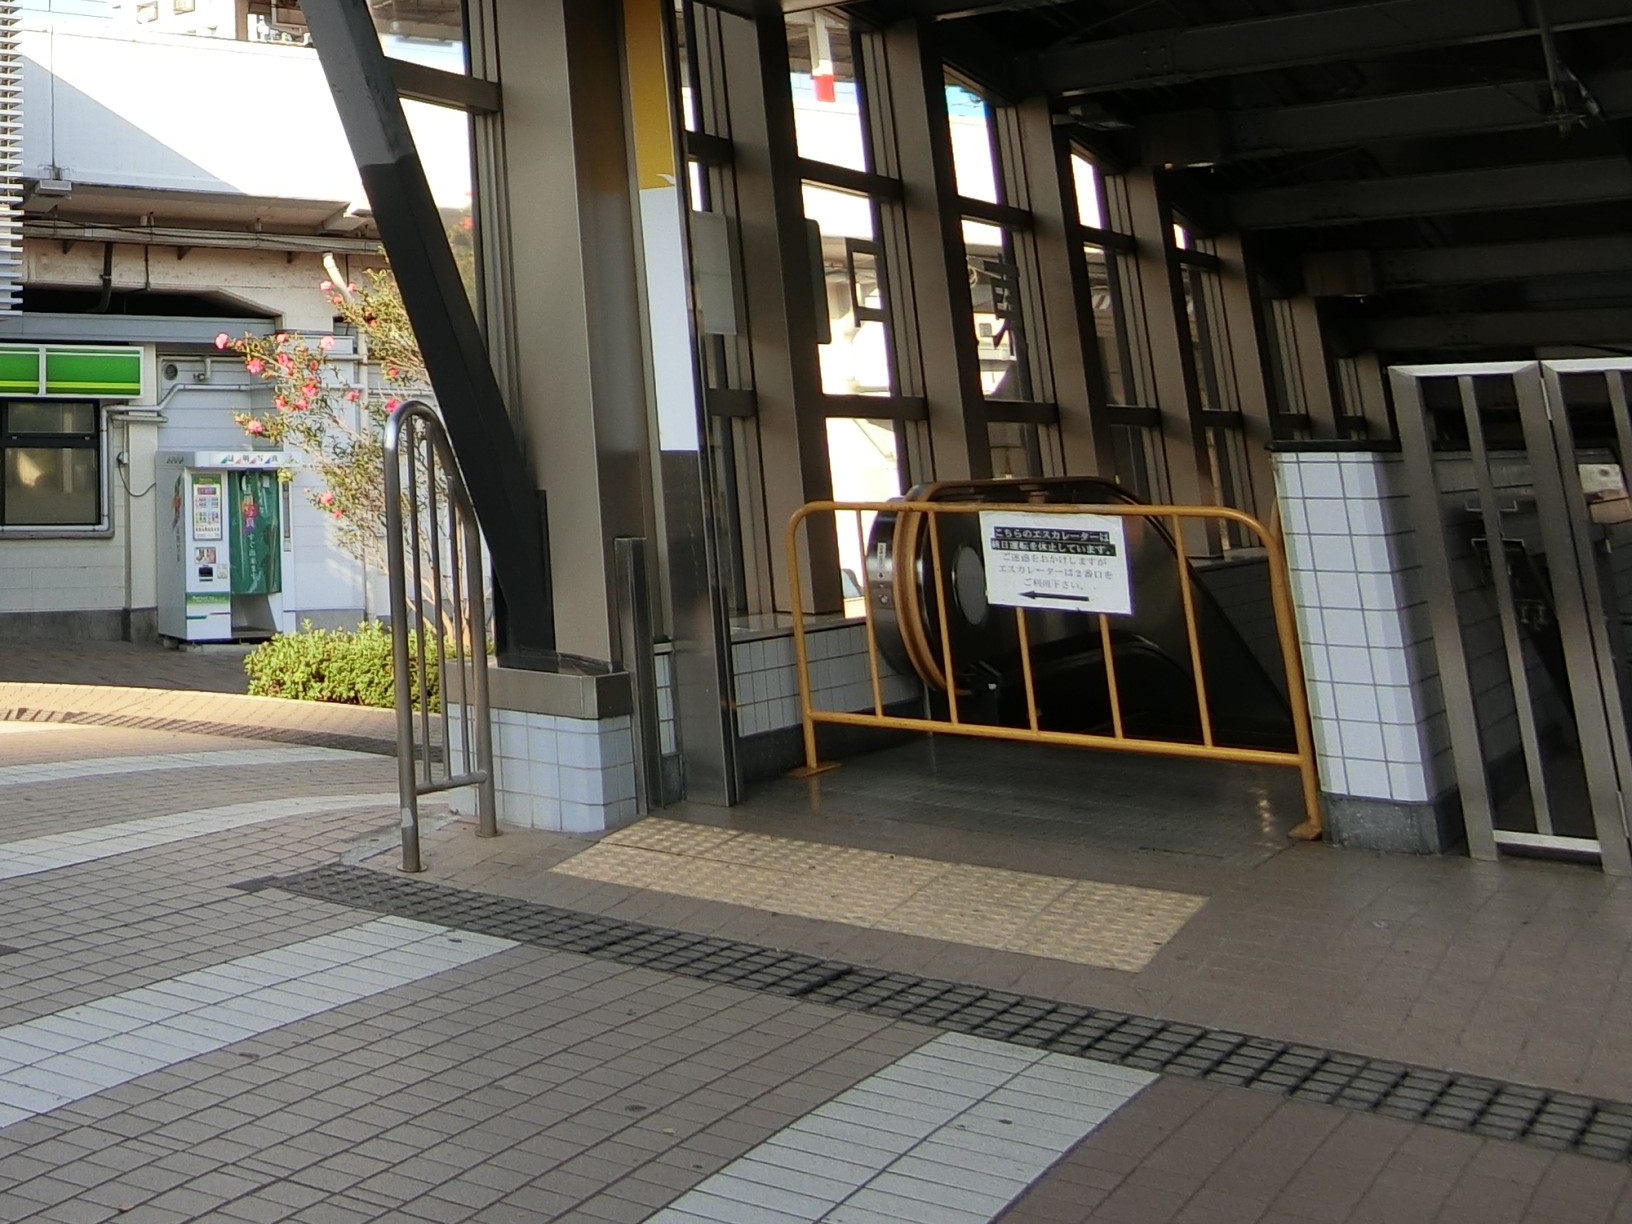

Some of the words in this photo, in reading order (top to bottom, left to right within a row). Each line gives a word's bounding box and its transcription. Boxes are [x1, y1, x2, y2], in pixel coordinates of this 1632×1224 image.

[995, 528, 1109, 542] こちらのエスカレーターは
[991, 540, 1112, 555] 終日運転を休止しています。
